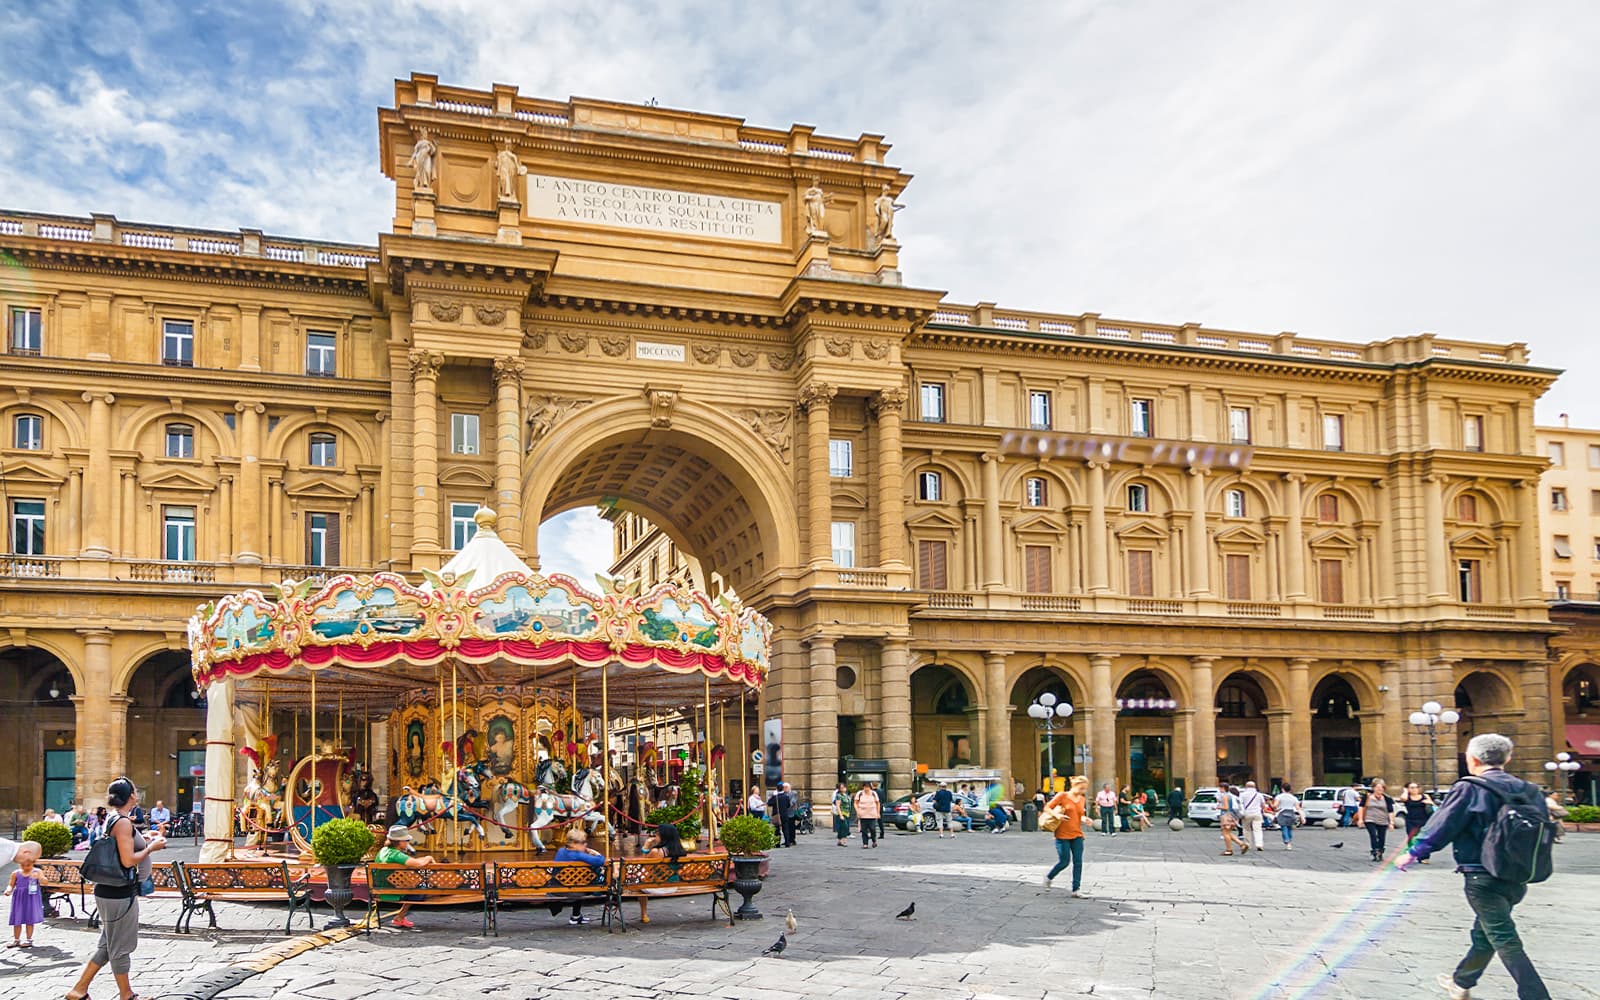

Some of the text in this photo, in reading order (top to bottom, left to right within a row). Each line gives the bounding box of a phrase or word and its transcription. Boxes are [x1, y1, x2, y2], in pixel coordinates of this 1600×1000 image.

[557, 193, 754, 225] DA SECOLARE SQUALLORE
[612, 186, 672, 203] CENTRO
[677, 194, 726, 209] DELLA
[558, 206, 754, 236] A VITA NUOVA RESTITUITO
